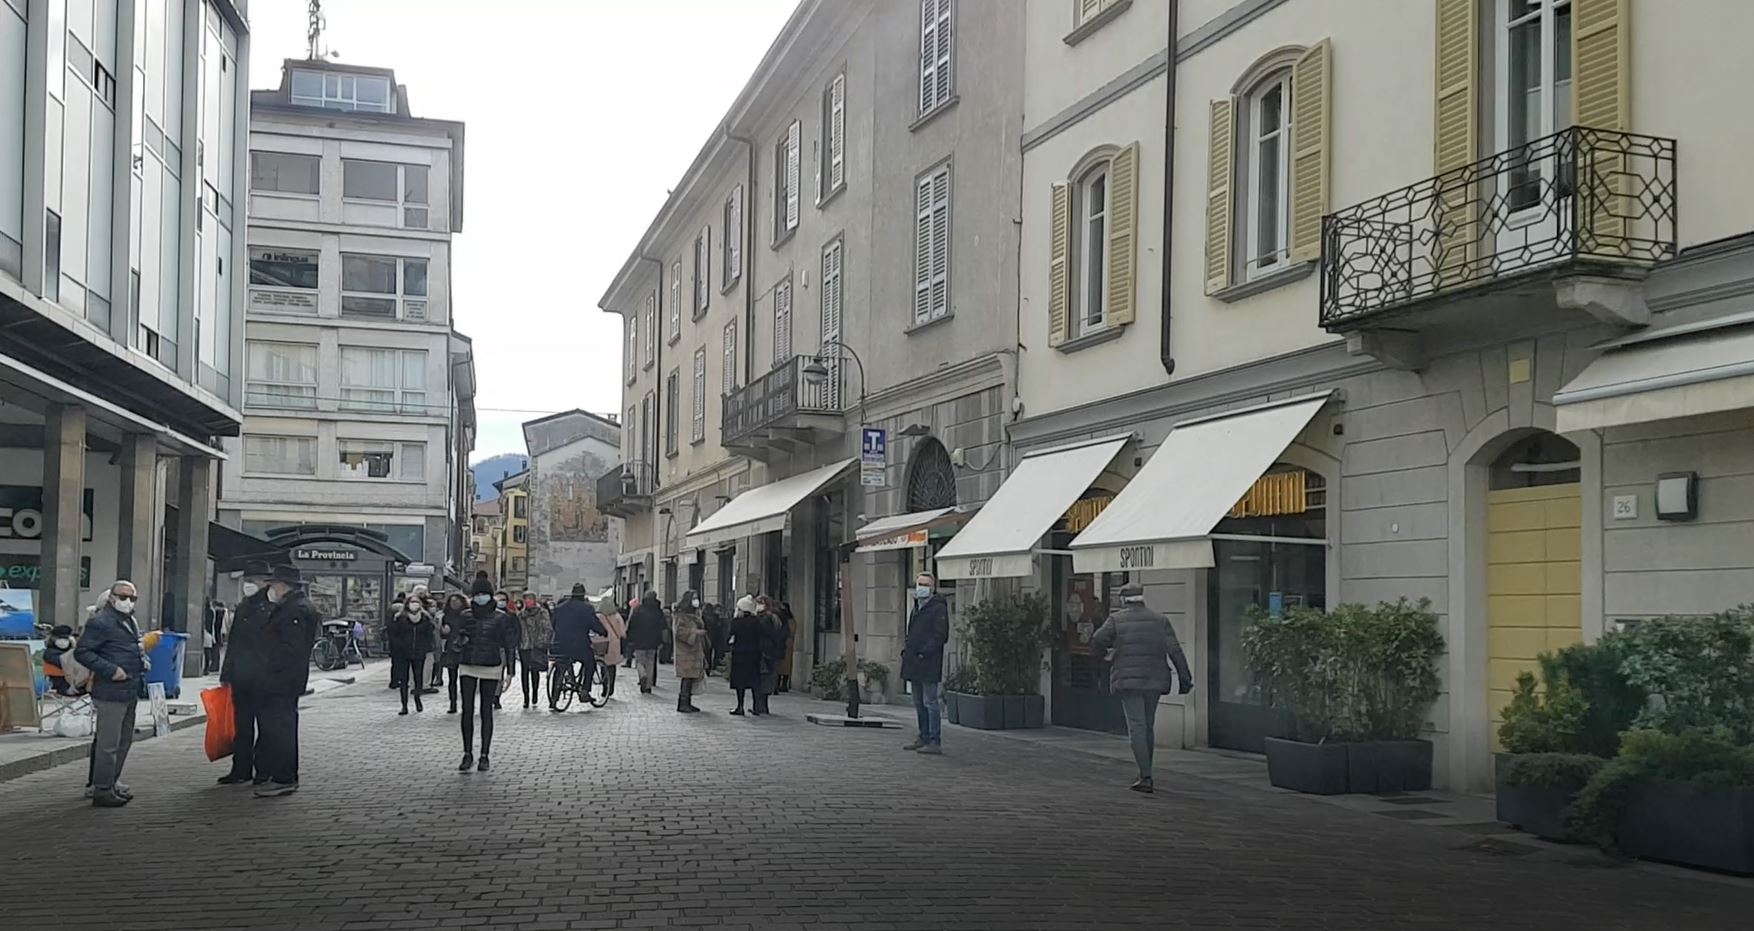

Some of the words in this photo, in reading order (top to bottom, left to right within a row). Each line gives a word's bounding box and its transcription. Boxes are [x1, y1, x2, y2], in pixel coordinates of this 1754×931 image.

[868, 431, 880, 450] T
[1616, 500, 1631, 513] 26
[298, 549, 310, 559] La
[311, 550, 354, 560] Provincia
[1120, 545, 1154, 568] SPONTINI
